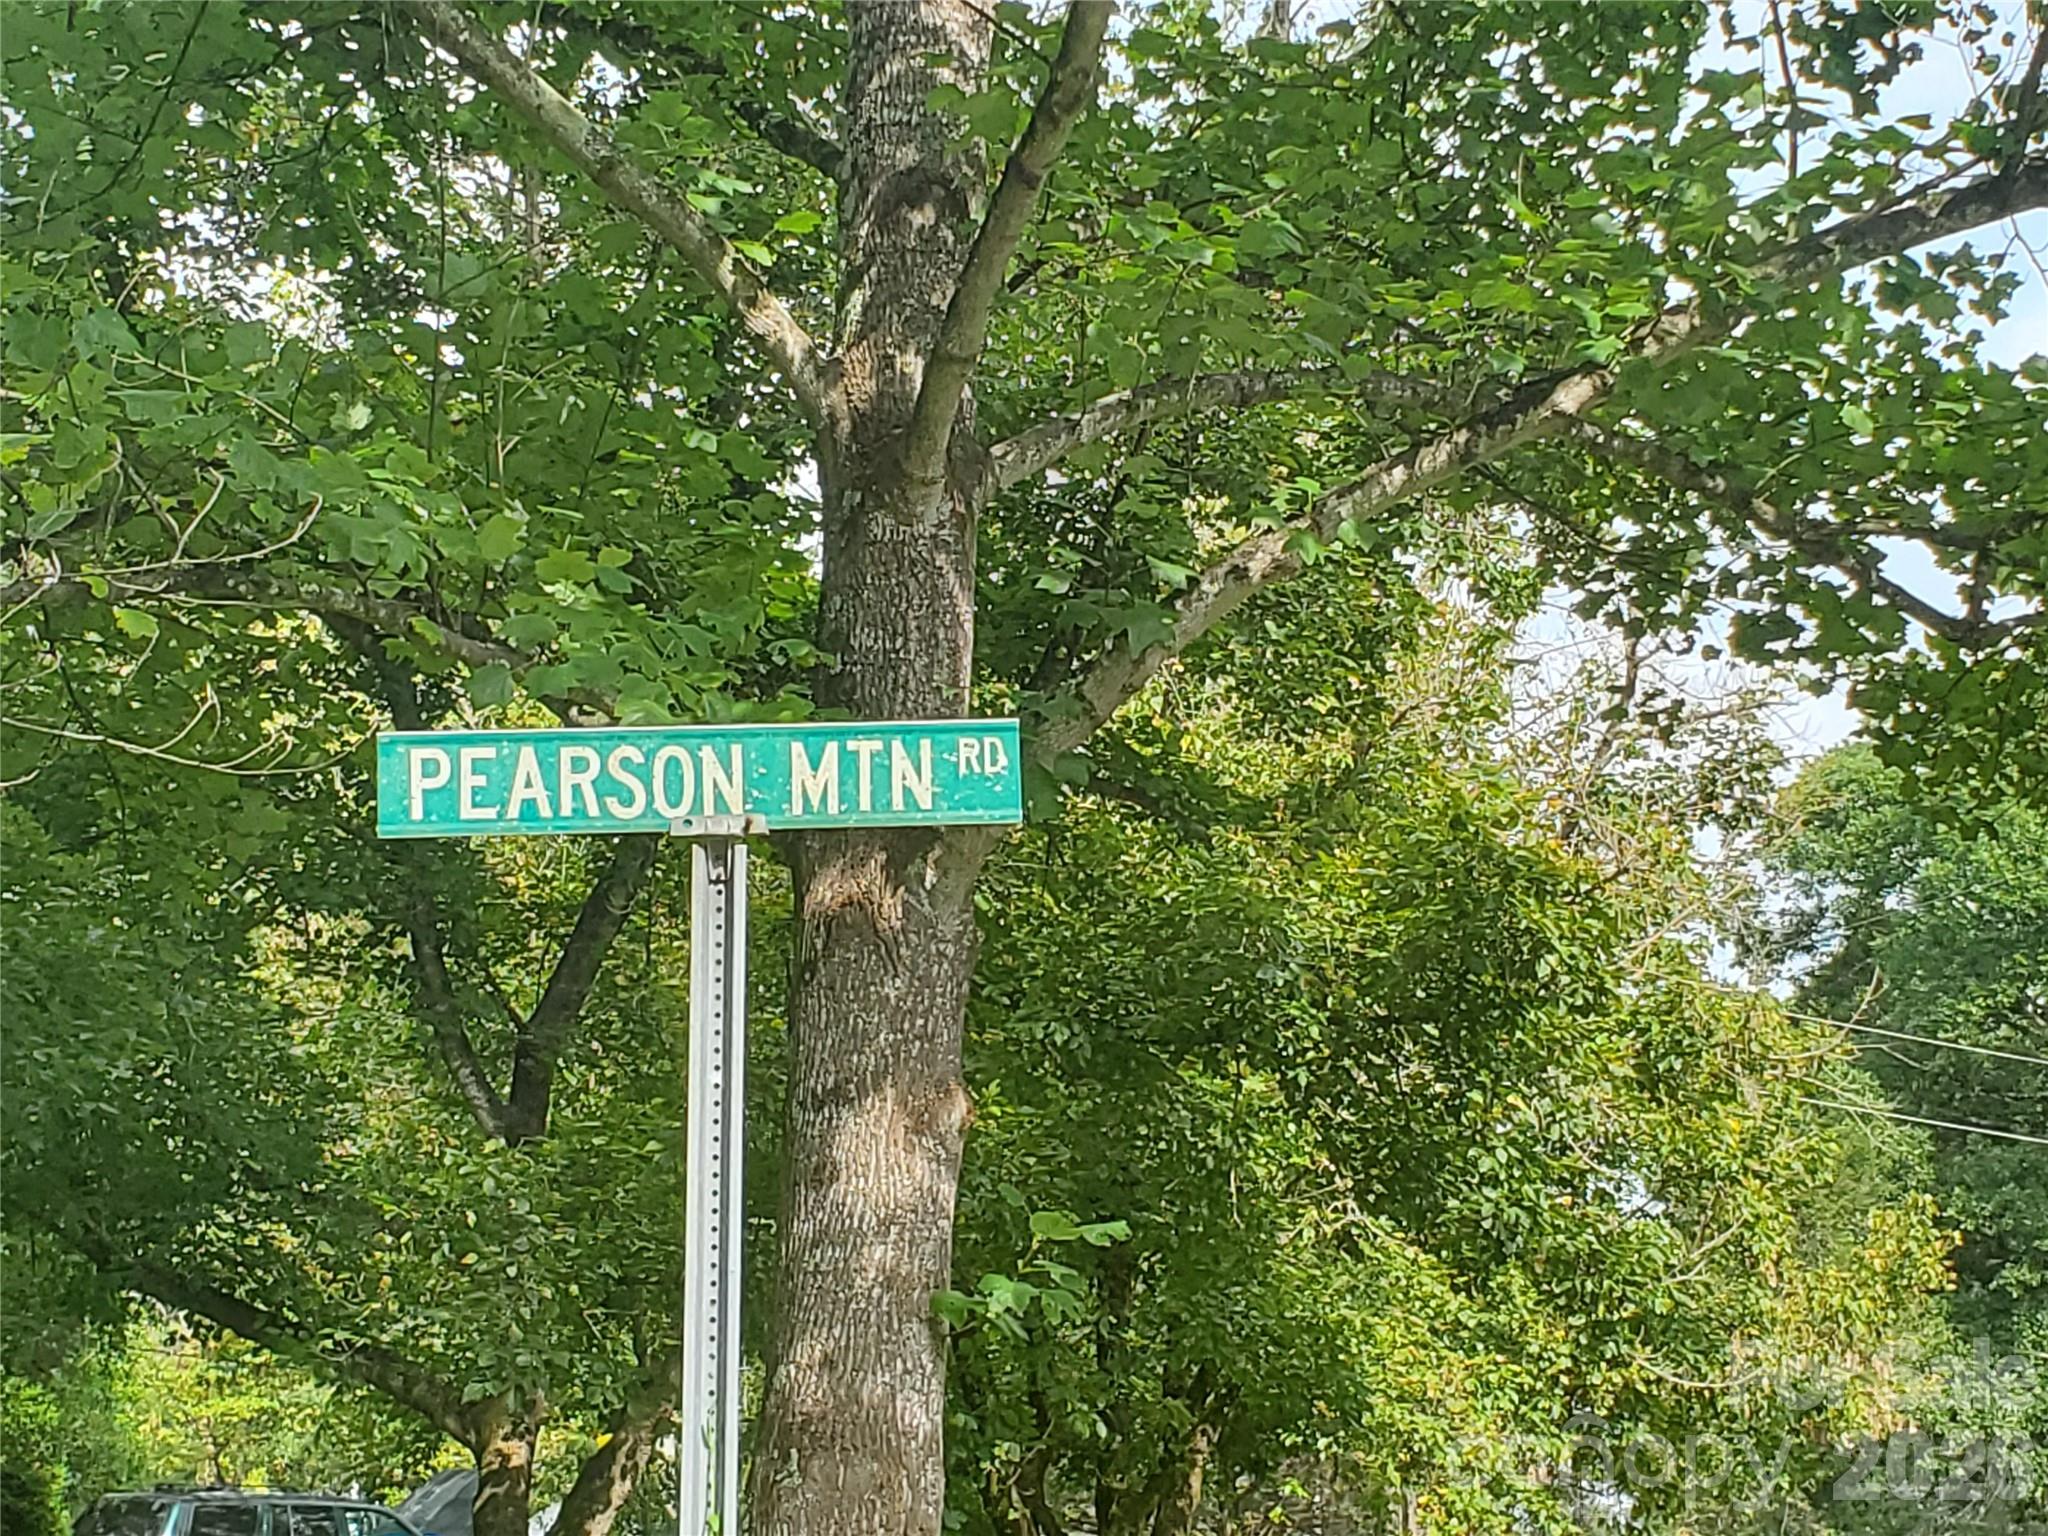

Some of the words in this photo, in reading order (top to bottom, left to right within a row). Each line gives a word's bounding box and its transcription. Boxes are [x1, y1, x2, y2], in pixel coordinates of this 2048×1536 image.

[408, 743, 744, 820] PEARSON
[790, 738, 933, 815] MTN
[958, 736, 1008, 775] RD
